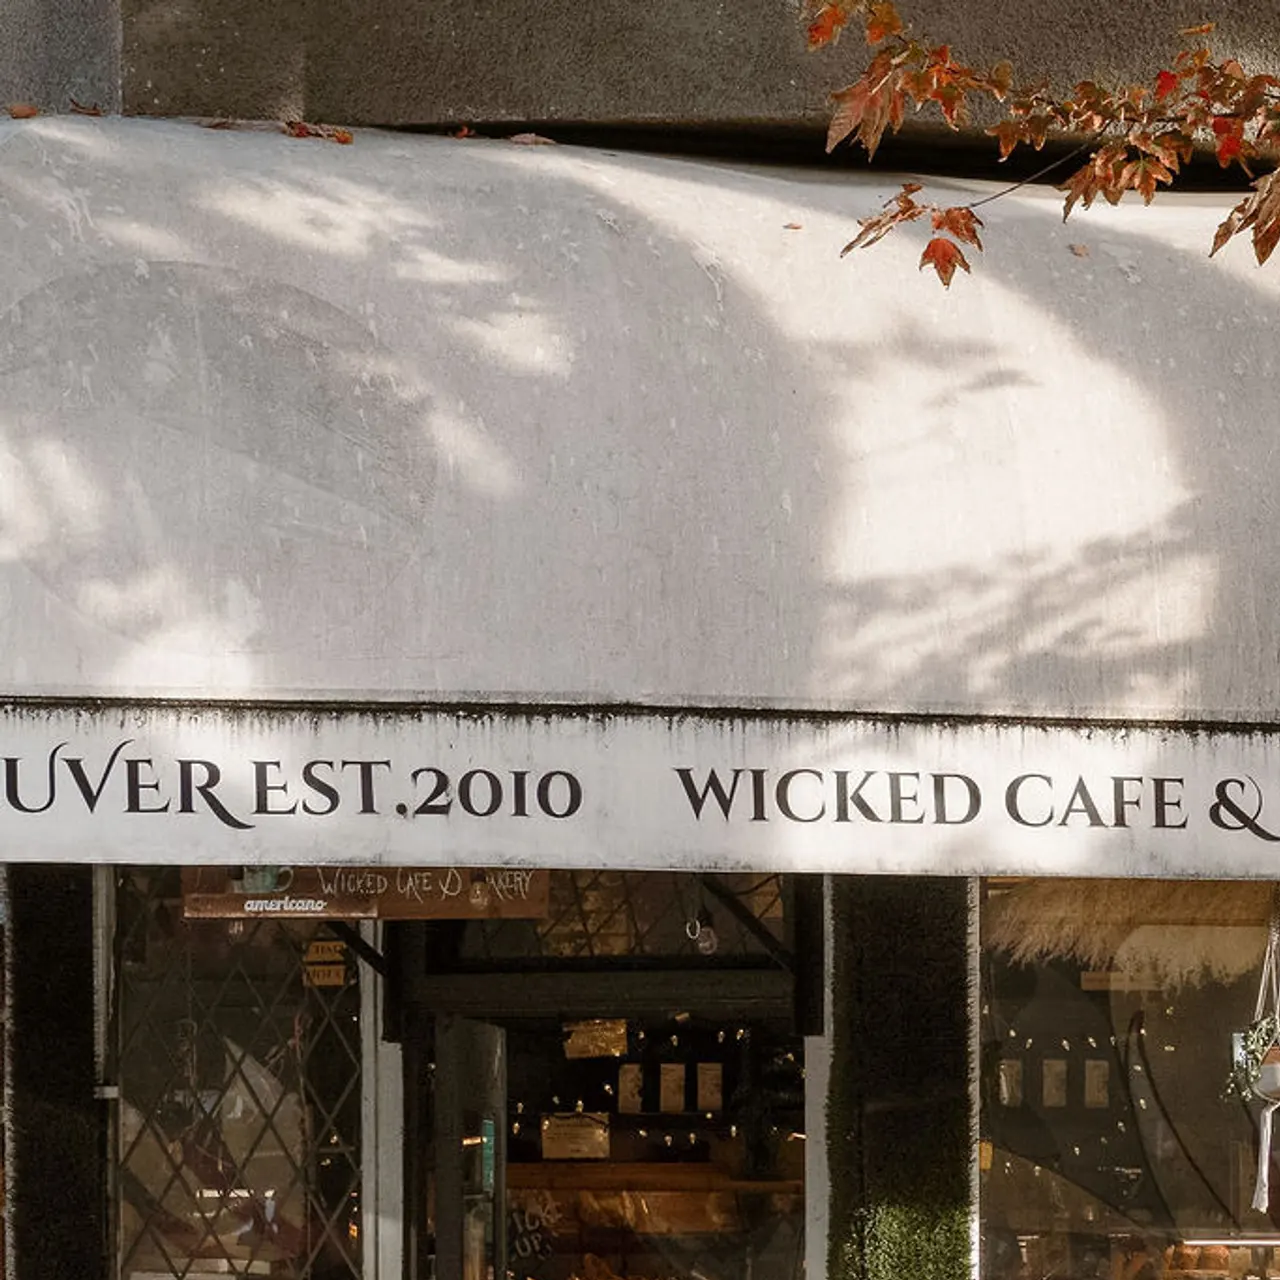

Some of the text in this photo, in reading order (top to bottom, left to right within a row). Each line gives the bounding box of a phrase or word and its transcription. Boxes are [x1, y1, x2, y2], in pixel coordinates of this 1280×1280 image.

[675, 767, 982, 825] WICKED
[1005, 773, 1187, 830] CAFE
[244, 896, 328, 912] americano
